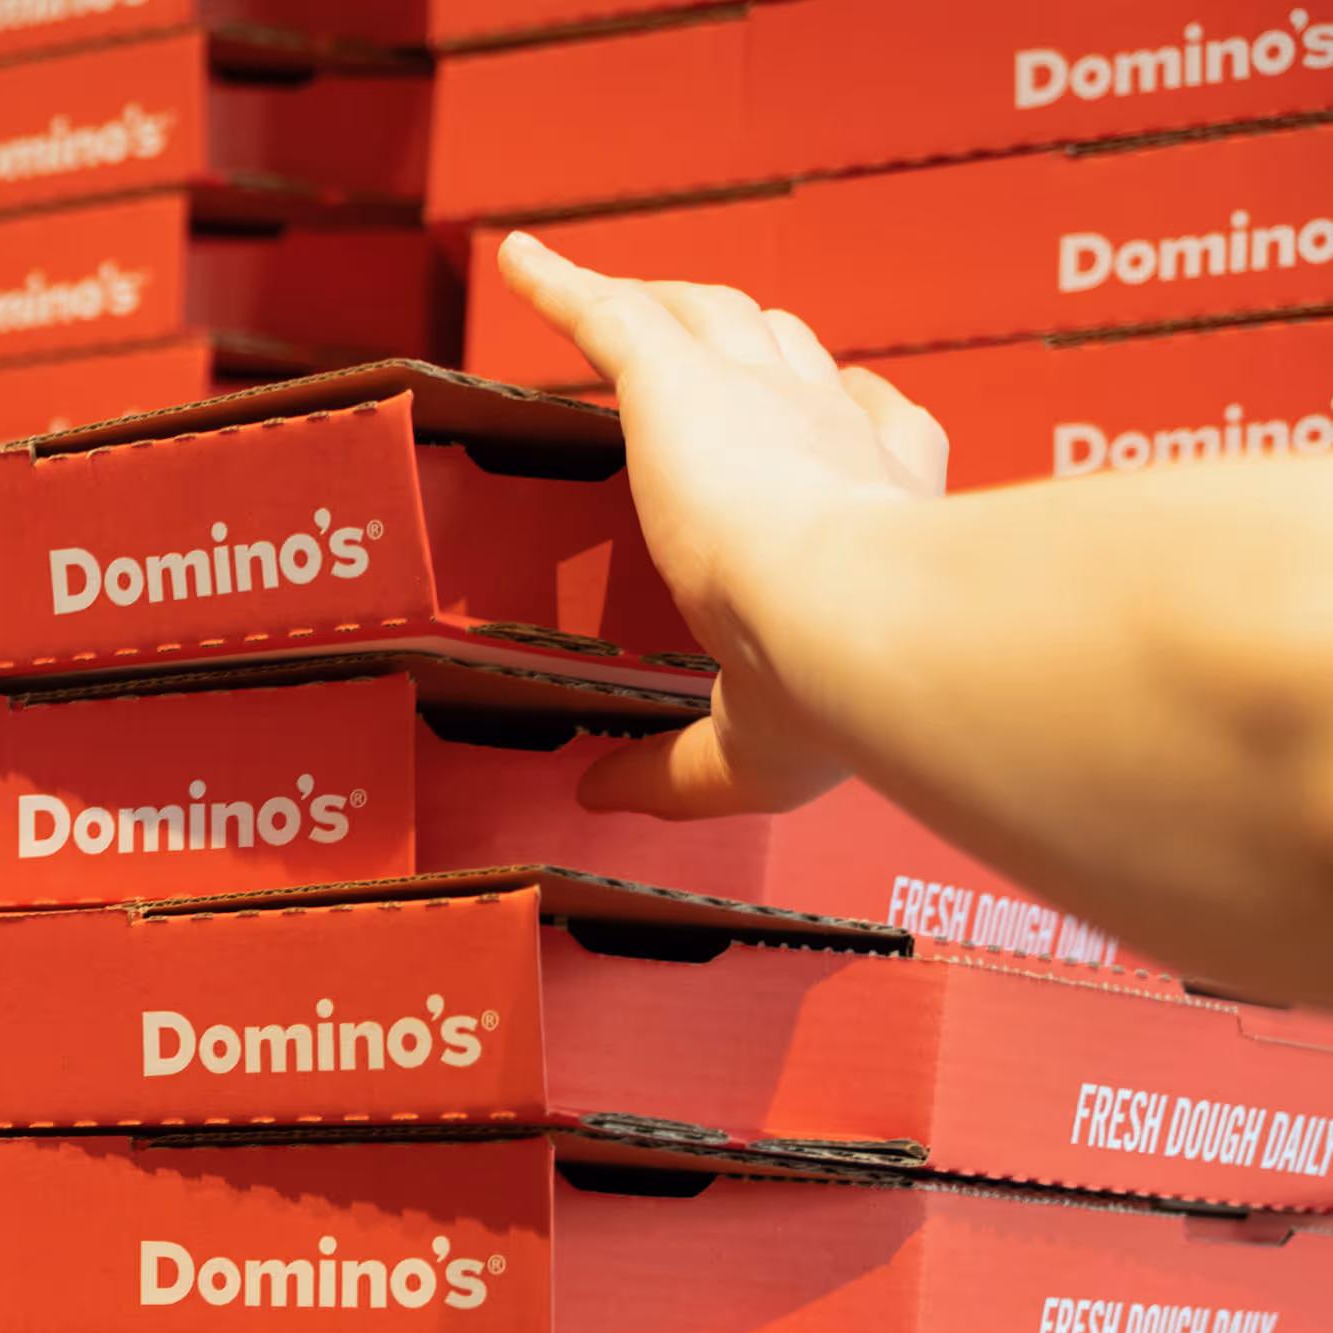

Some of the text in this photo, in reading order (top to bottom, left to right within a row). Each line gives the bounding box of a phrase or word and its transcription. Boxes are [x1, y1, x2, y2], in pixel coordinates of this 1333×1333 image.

[1015, 9, 1333, 109] Domino's
[1059, 210, 1333, 292] Domino
[887, 875, 974, 942] FRESH
[971, 894, 1059, 957] DOUGH
[1071, 1083, 1168, 1155] FRESH
[1164, 1097, 1267, 1168] DOUGH
